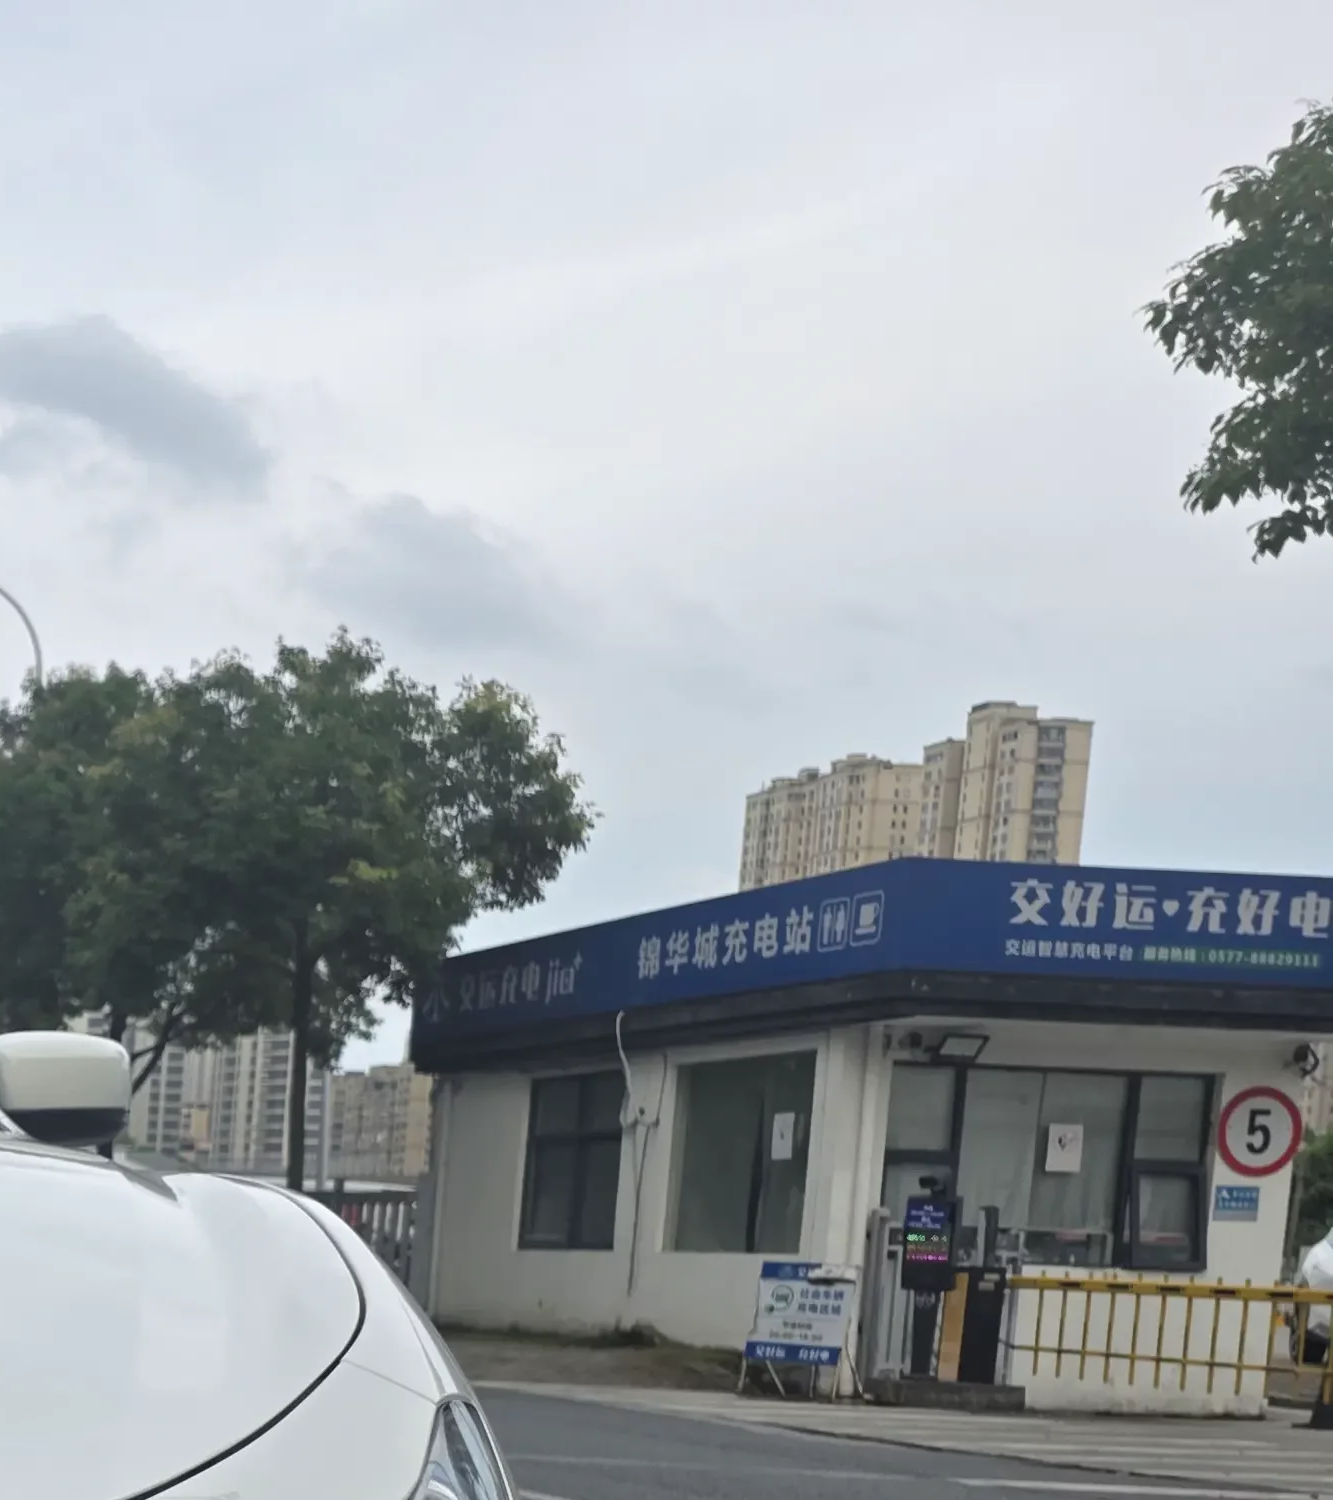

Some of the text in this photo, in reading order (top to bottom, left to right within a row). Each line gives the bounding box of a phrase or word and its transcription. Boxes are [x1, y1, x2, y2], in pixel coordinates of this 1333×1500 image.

[1009, 878, 1331, 938] 交好运 充好电
[638, 905, 815, 981] 锦华城充电站
[1246, 1108, 1271, 1154] 5
